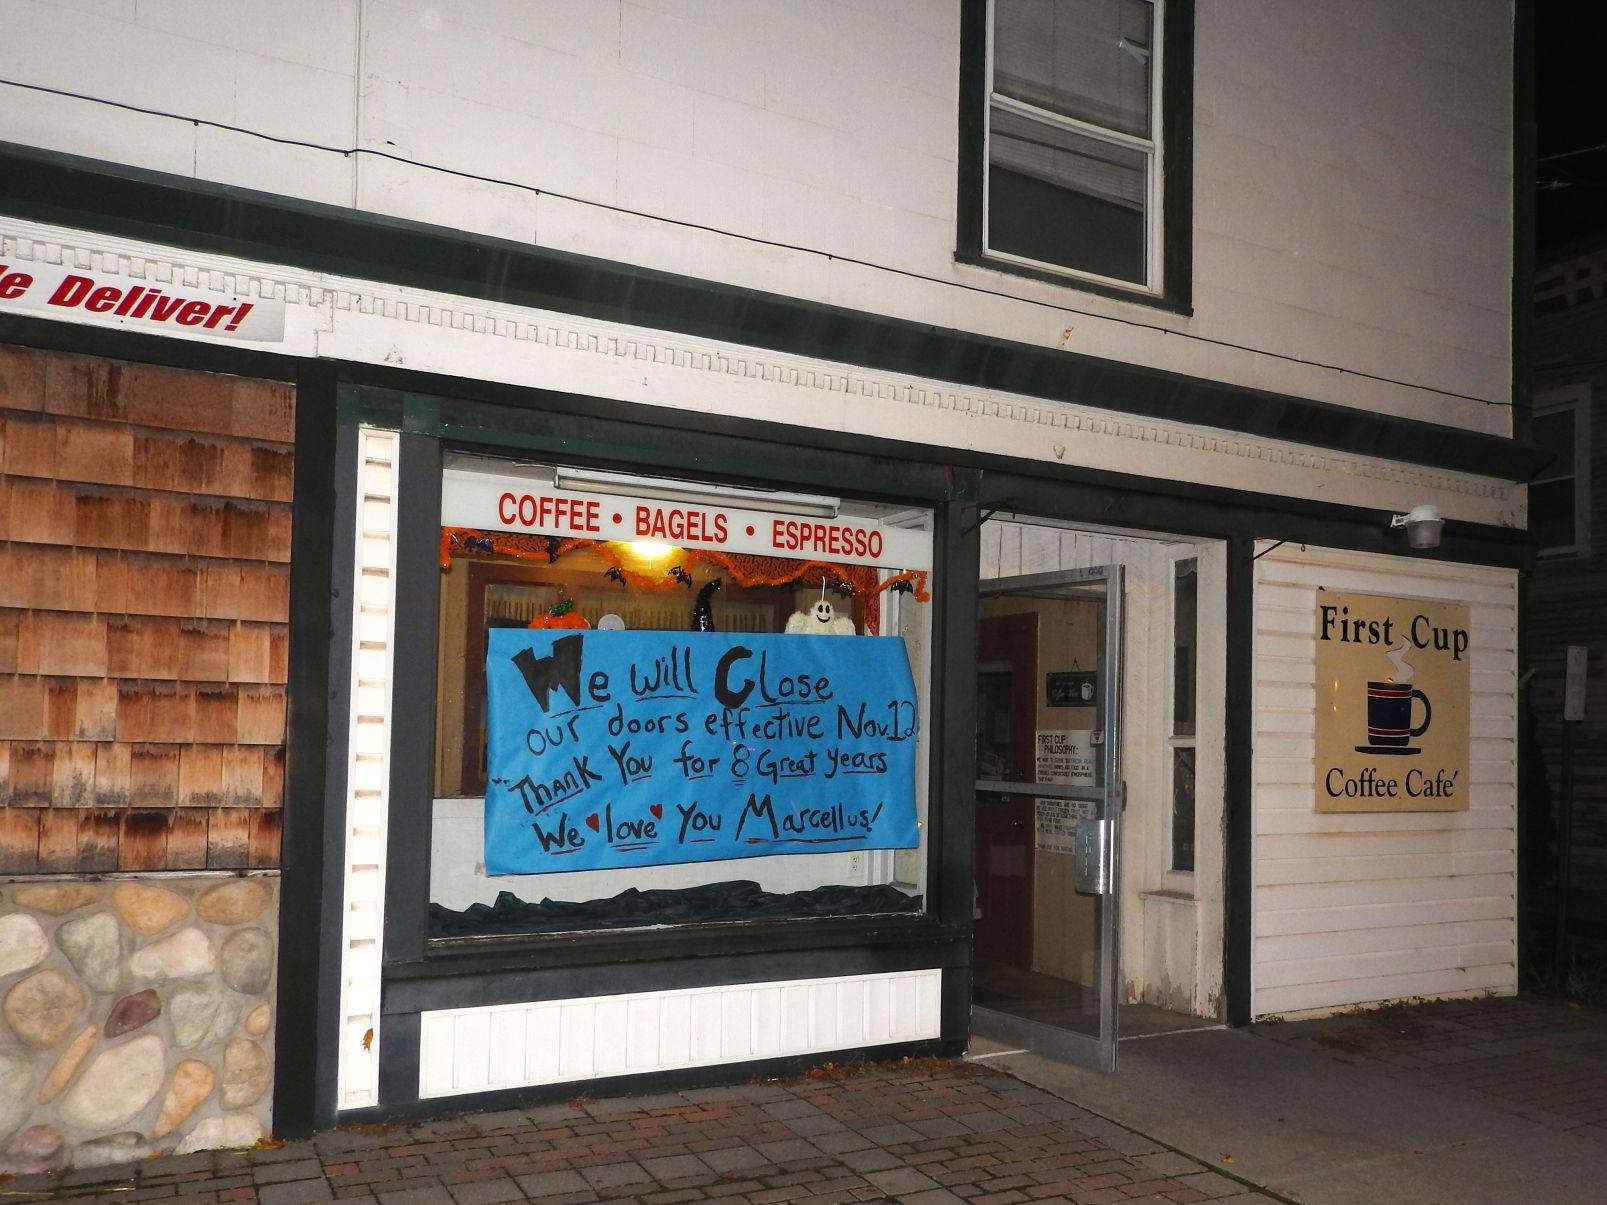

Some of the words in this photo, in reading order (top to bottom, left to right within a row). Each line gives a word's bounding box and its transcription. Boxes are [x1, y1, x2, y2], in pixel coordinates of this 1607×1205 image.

[47, 274, 254, 332] Deliver!
[498, 492, 601, 532] COFFEE
[635, 505, 728, 544] BAGELS
[772, 519, 883, 558] ESPRESSO
[1319, 605, 1394, 646] First
[1410, 614, 1468, 661] Cup
[511, 633, 611, 713] We
[714, 645, 834, 710] Close
[608, 702, 689, 737] doors
[704, 706, 825, 741] effective
[1038, 734, 1053, 745] FIRST
[607, 741, 653, 786] You
[673, 740, 720, 777] for
[731, 743, 750, 778] 8
[756, 748, 818, 785] Great
[1325, 767, 1398, 798] Coffee
[531, 811, 586, 852] We
[734, 792, 883, 842] Marcellus!
